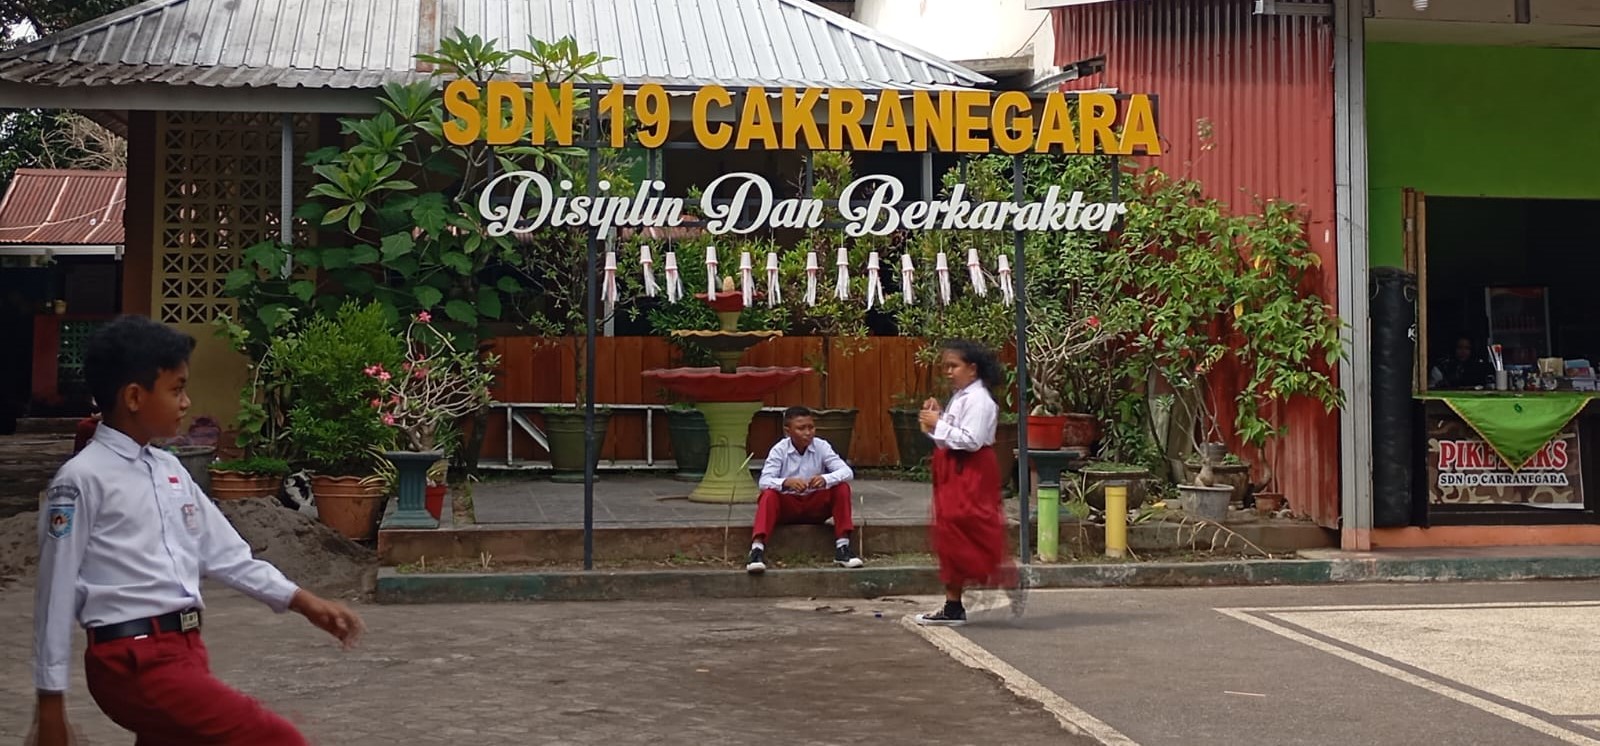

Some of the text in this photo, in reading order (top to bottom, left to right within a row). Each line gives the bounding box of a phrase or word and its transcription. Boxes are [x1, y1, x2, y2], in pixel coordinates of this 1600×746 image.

[442, 79, 1162, 156] SDN 19 CAKRANEGARA
[478, 170, 1127, 241] Disiplin Dan Berkarakter
[1438, 441, 1509, 469] PIKE
[1439, 473, 1567, 485] SDN 19 CAKRANEGARA
